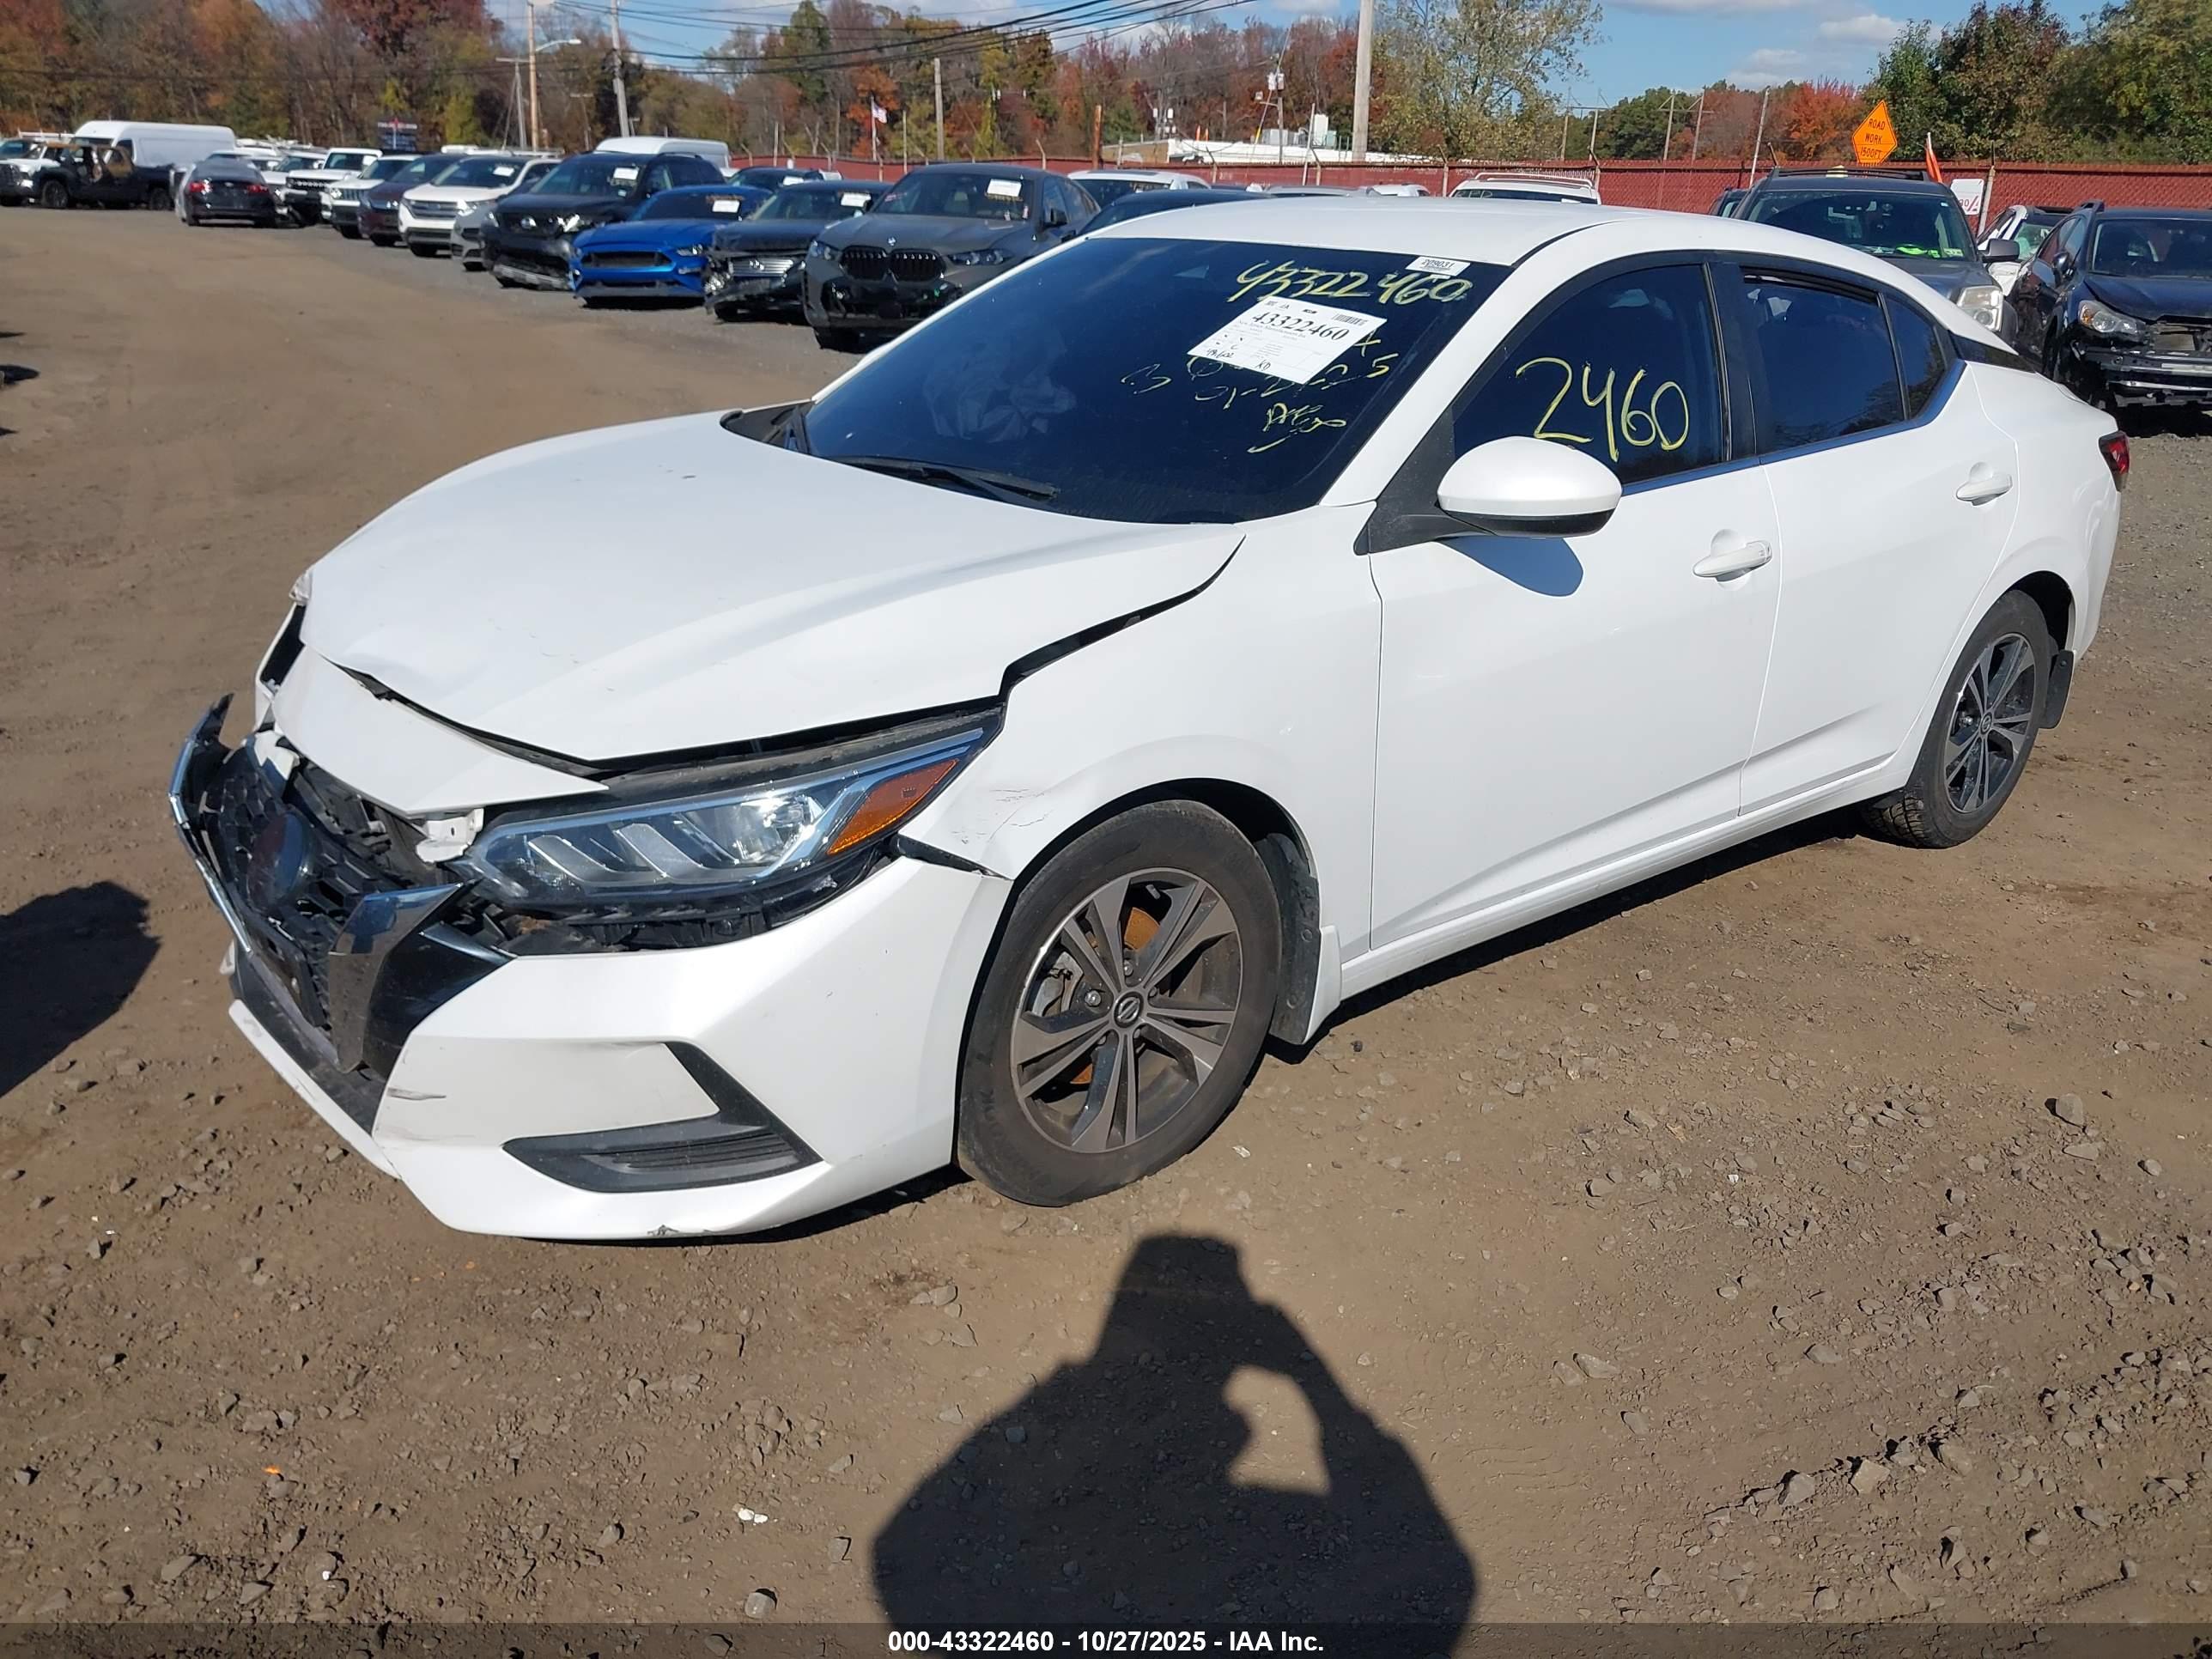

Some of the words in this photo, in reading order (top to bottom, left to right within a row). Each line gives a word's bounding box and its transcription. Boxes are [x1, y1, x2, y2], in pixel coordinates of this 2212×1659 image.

[1868, 118, 1886, 131] ROAD
[1864, 132, 1883, 144] WORK
[1860, 146, 1883, 160] 1500FT
[1252, 312, 1350, 341] 43322460
[1516, 356, 1690, 462] 2460
